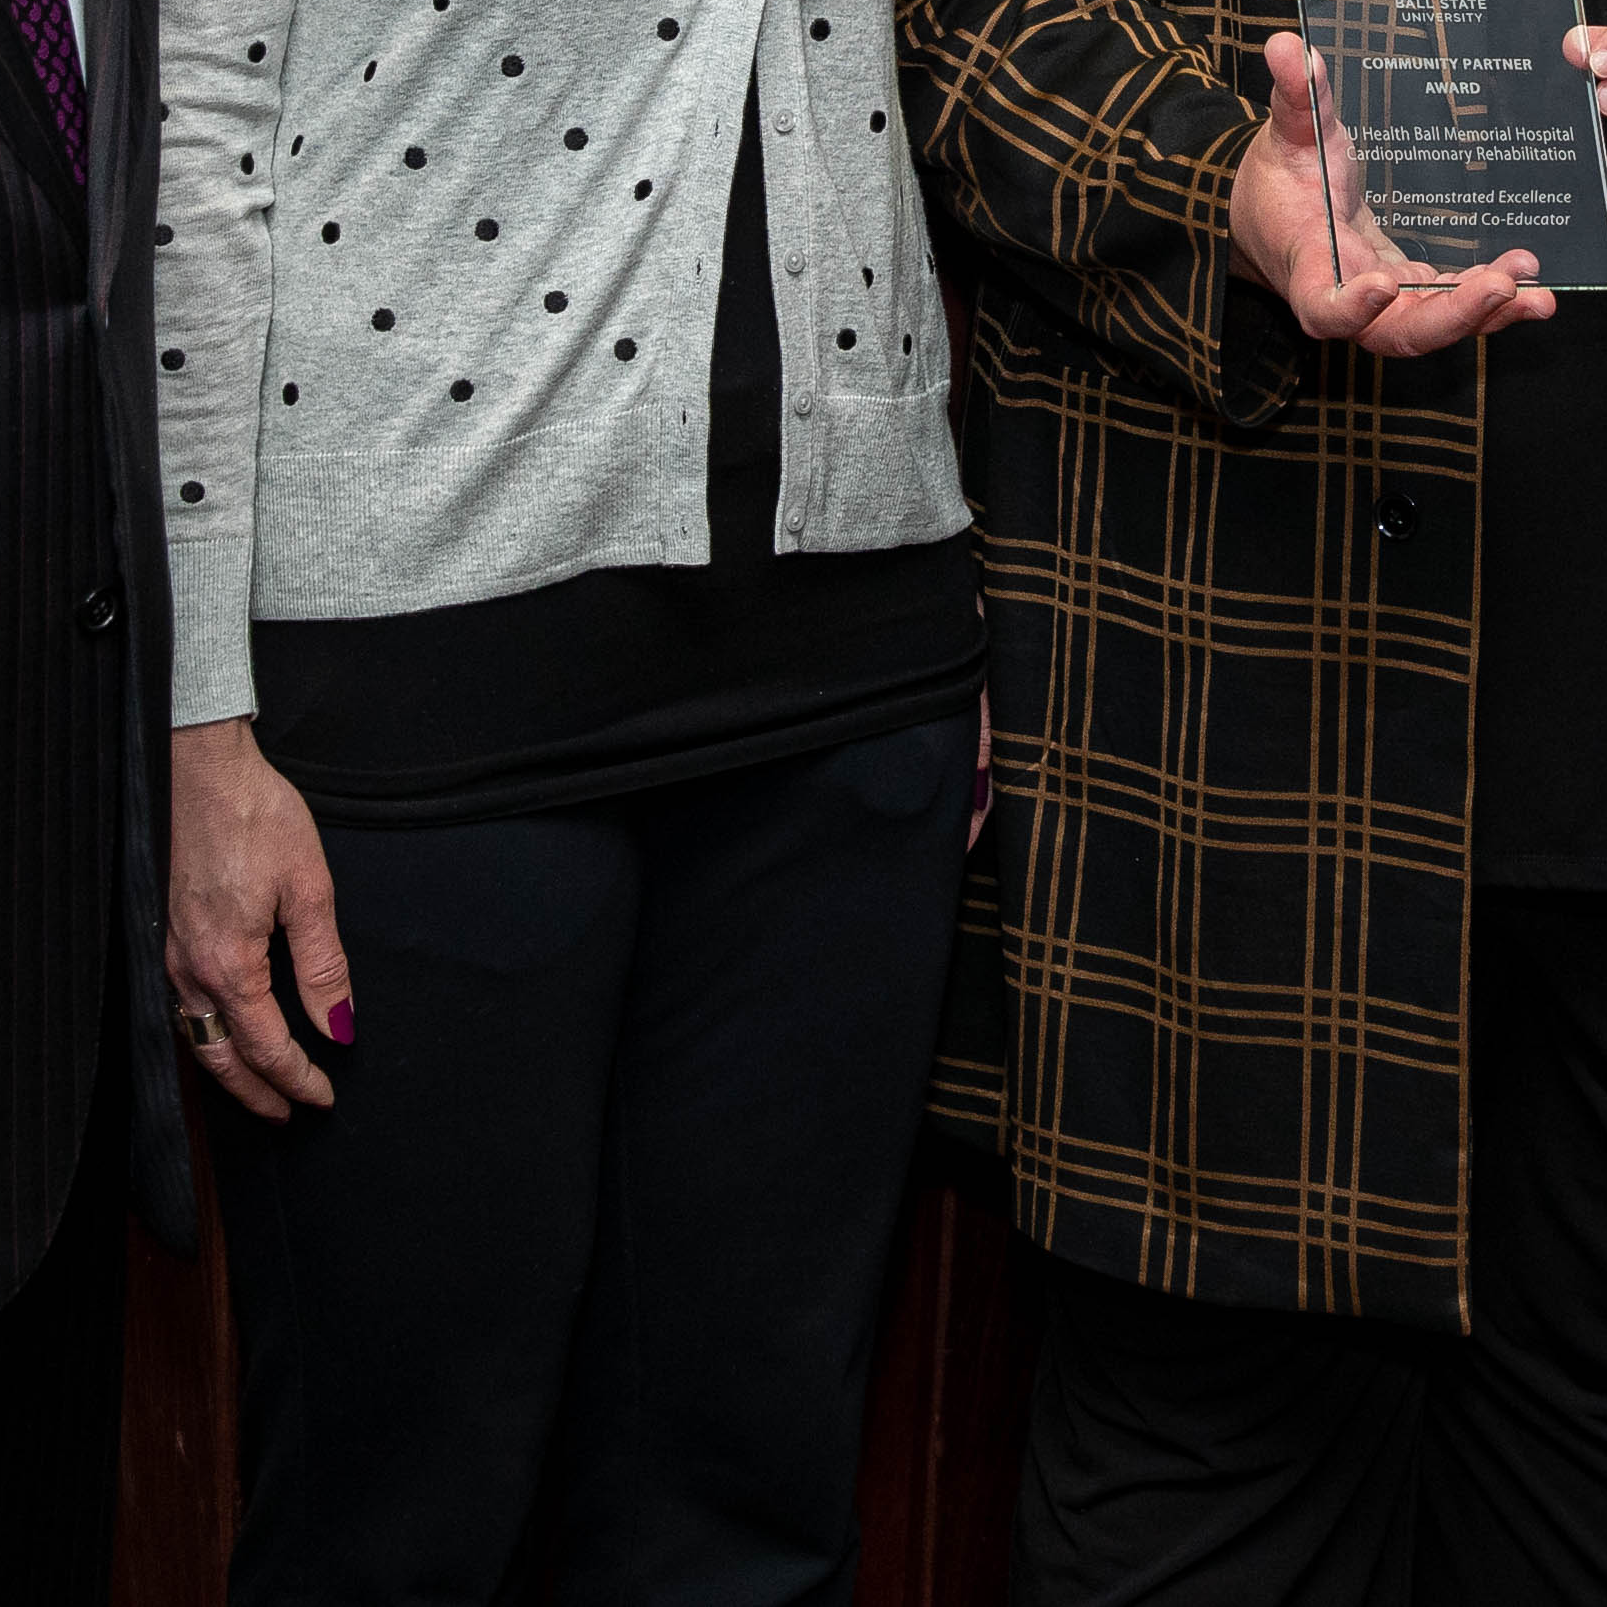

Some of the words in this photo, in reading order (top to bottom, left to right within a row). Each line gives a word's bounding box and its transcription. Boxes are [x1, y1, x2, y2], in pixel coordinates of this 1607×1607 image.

[1402, 12, 1483, 23] UNIVERSITY
[1362, 57, 1459, 70] COMMUNITY
[1462, 58, 1533, 70] PARTNER
[1425, 81, 1481, 94] AWARD
[1362, 126, 1410, 141] Health
[1413, 126, 1440, 141] Ball
[1444, 126, 1511, 141] Memorial
[1515, 126, 1575, 145] Hospital
[1346, 145, 1473, 165] Cardiopulmonary
[1476, 145, 1576, 161] Rehabilitation
[1365, 190, 1388, 204] For
[1391, 190, 1495, 204] Demonstrated
[1498, 190, 1572, 204] Excellence
[1372, 216, 1388, 226] as
[1393, 213, 1447, 226] Partner
[1449, 212, 1478, 226] and
[1481, 212, 1571, 226] Co-Educator
